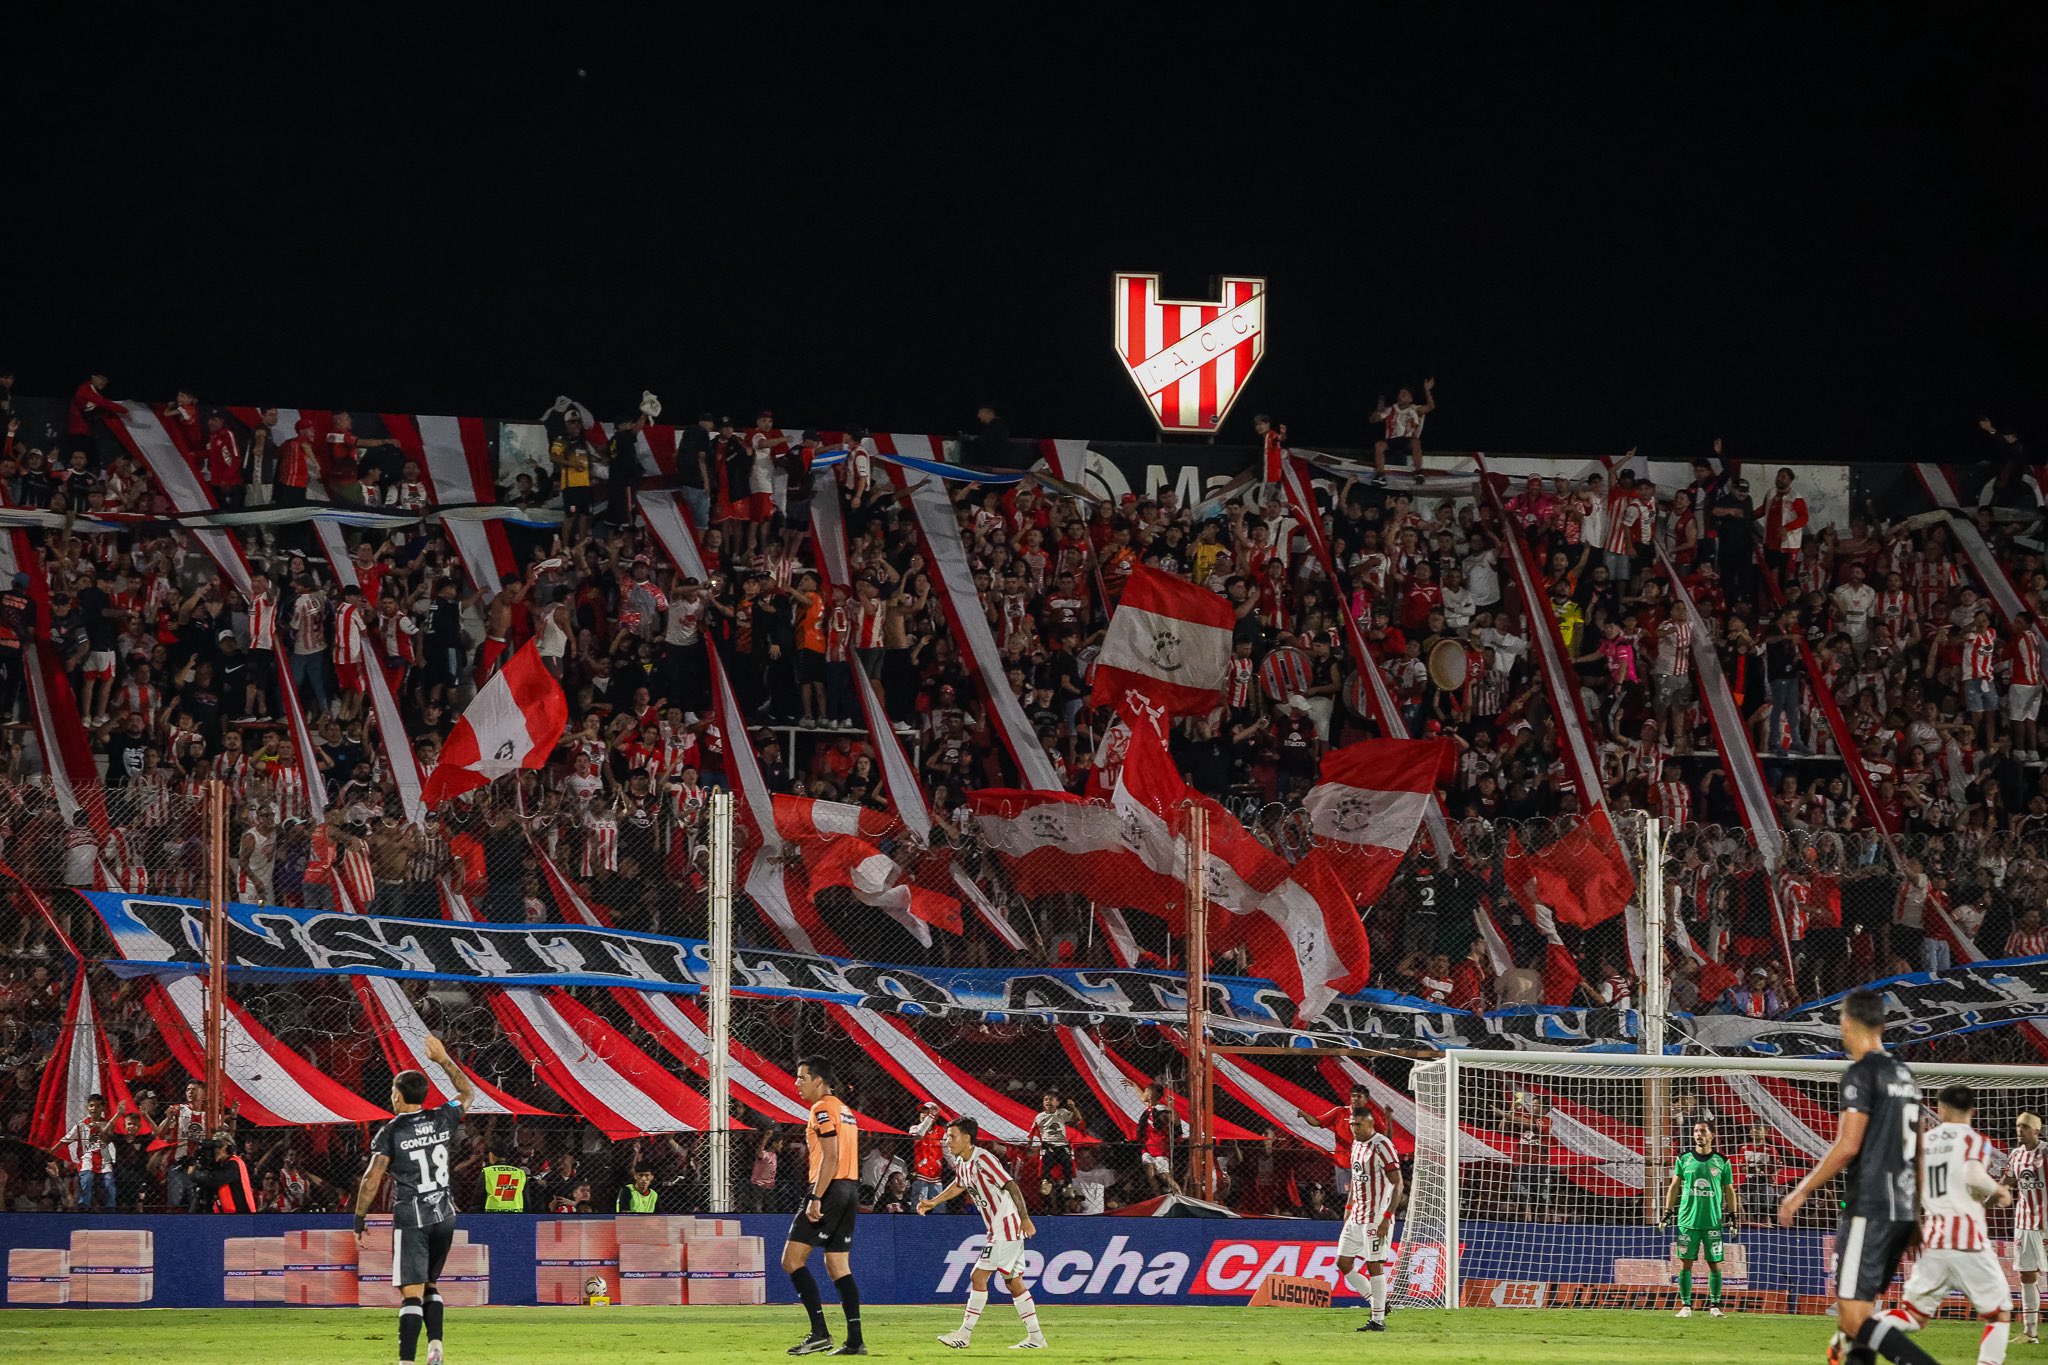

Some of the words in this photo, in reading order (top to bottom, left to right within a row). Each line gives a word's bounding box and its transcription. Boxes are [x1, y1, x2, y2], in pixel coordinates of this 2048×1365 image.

[400, 1130, 450, 1150] GONZALEZ
[409, 1143, 450, 1194] 18
[1928, 1162, 1948, 1199] 10
[1688, 1190, 1716, 1198] Macro
[935, 1233, 1191, 1296] fecha
